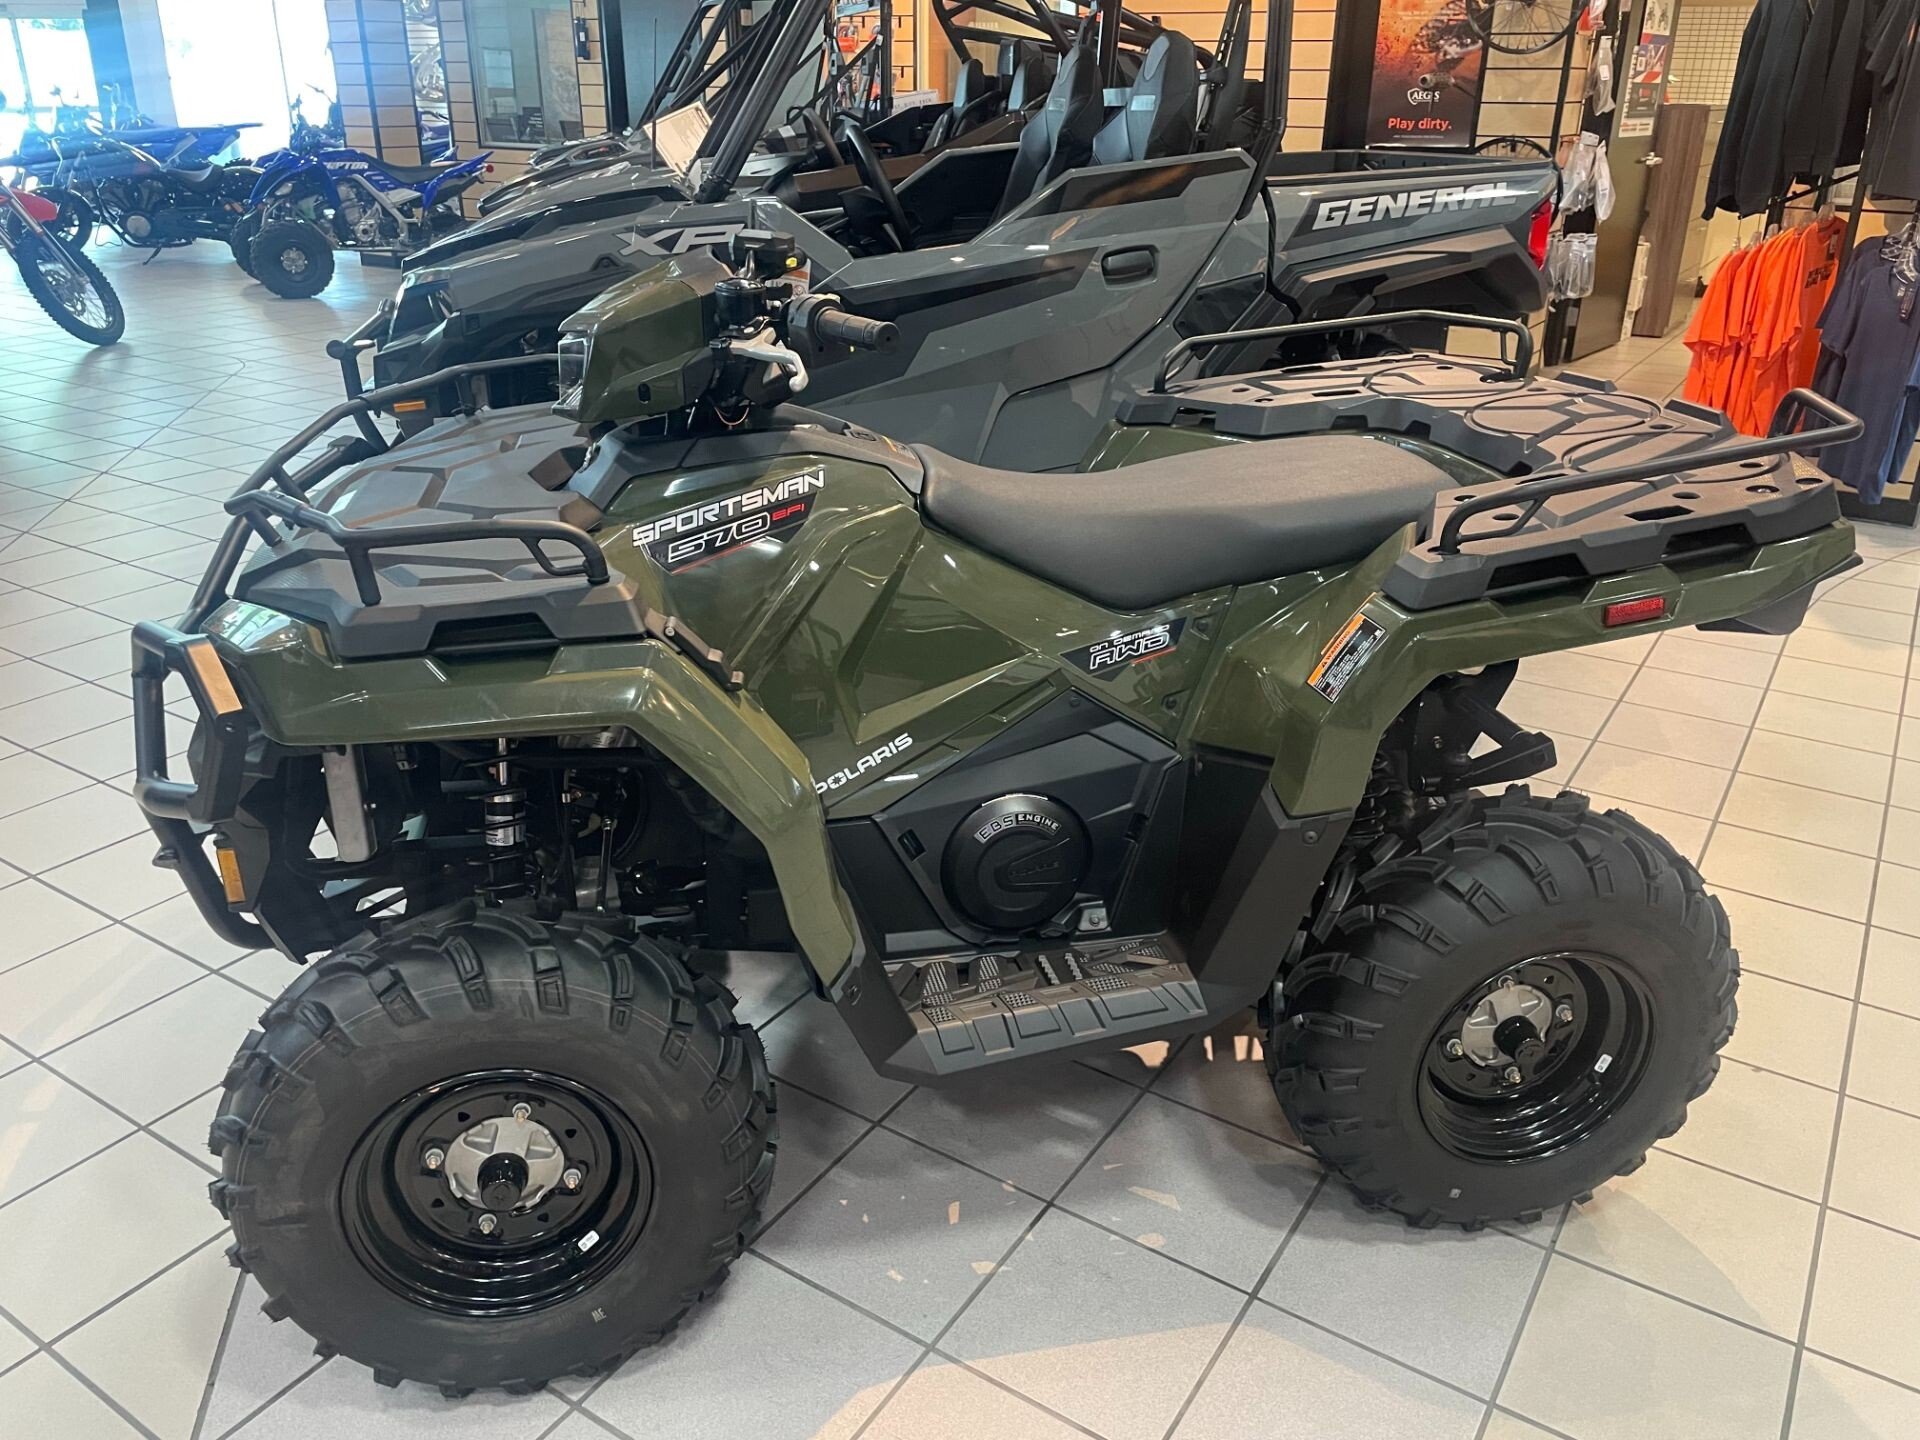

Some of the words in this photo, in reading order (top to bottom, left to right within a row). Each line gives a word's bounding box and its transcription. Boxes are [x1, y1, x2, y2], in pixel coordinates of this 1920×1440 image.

[1387, 117, 1415, 132] Play
[1418, 117, 1452, 132] dirty.
[1311, 182, 1517, 231] GENERAL
[633, 469, 825, 547] SPORTSMAN
[667, 511, 771, 564] 570
[772, 503, 805, 521] EFI
[1089, 632, 1170, 670] AWD
[979, 815, 1014, 840] EBS
[1017, 813, 1060, 831] ENGINE
